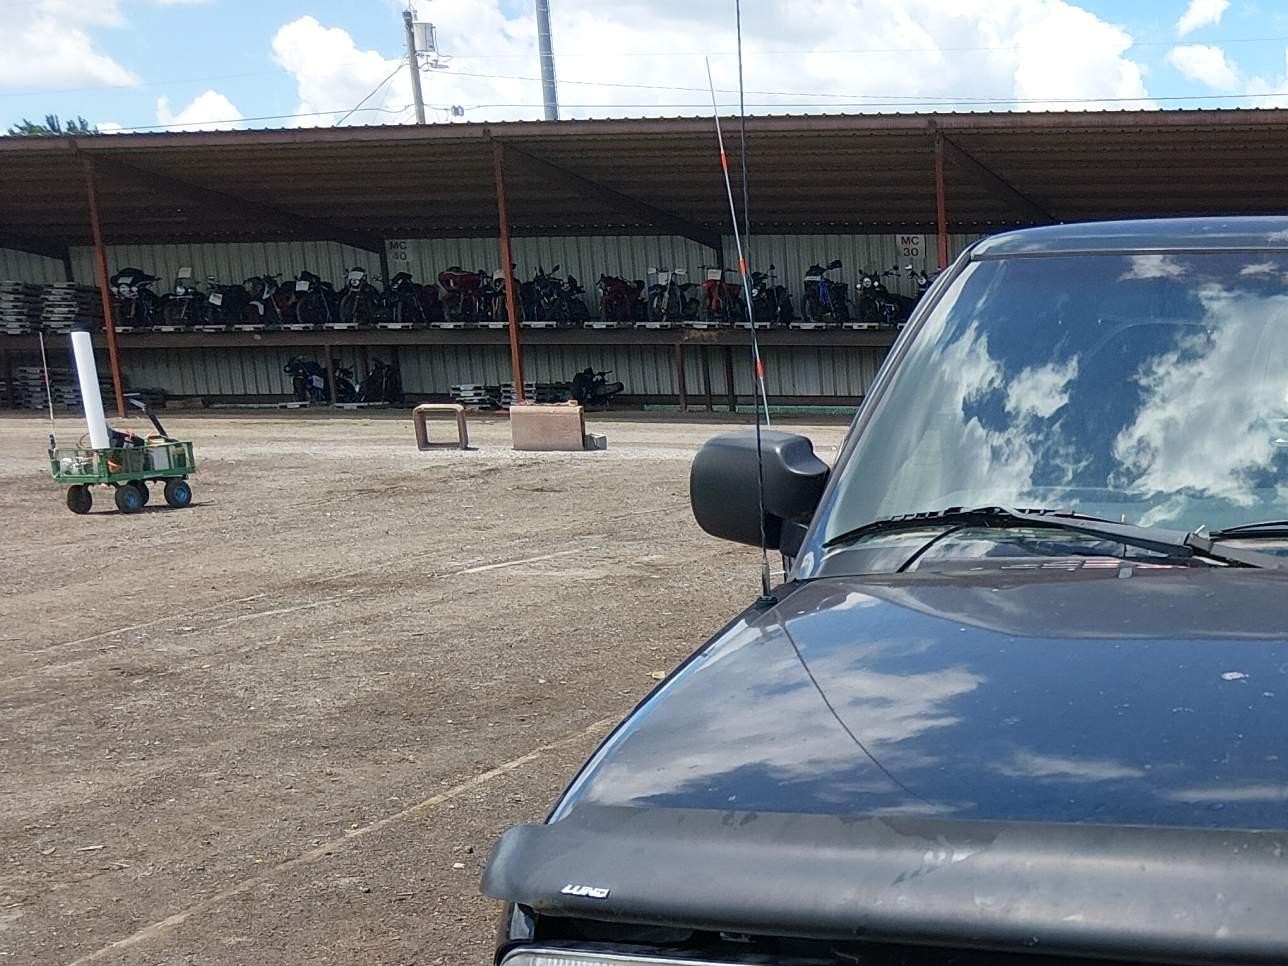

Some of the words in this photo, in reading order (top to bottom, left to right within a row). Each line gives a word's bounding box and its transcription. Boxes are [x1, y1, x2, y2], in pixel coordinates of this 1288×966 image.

[389, 240, 408, 250] MC
[901, 236, 919, 246] MC
[392, 251, 407, 261] 40
[903, 248, 919, 257] 30
